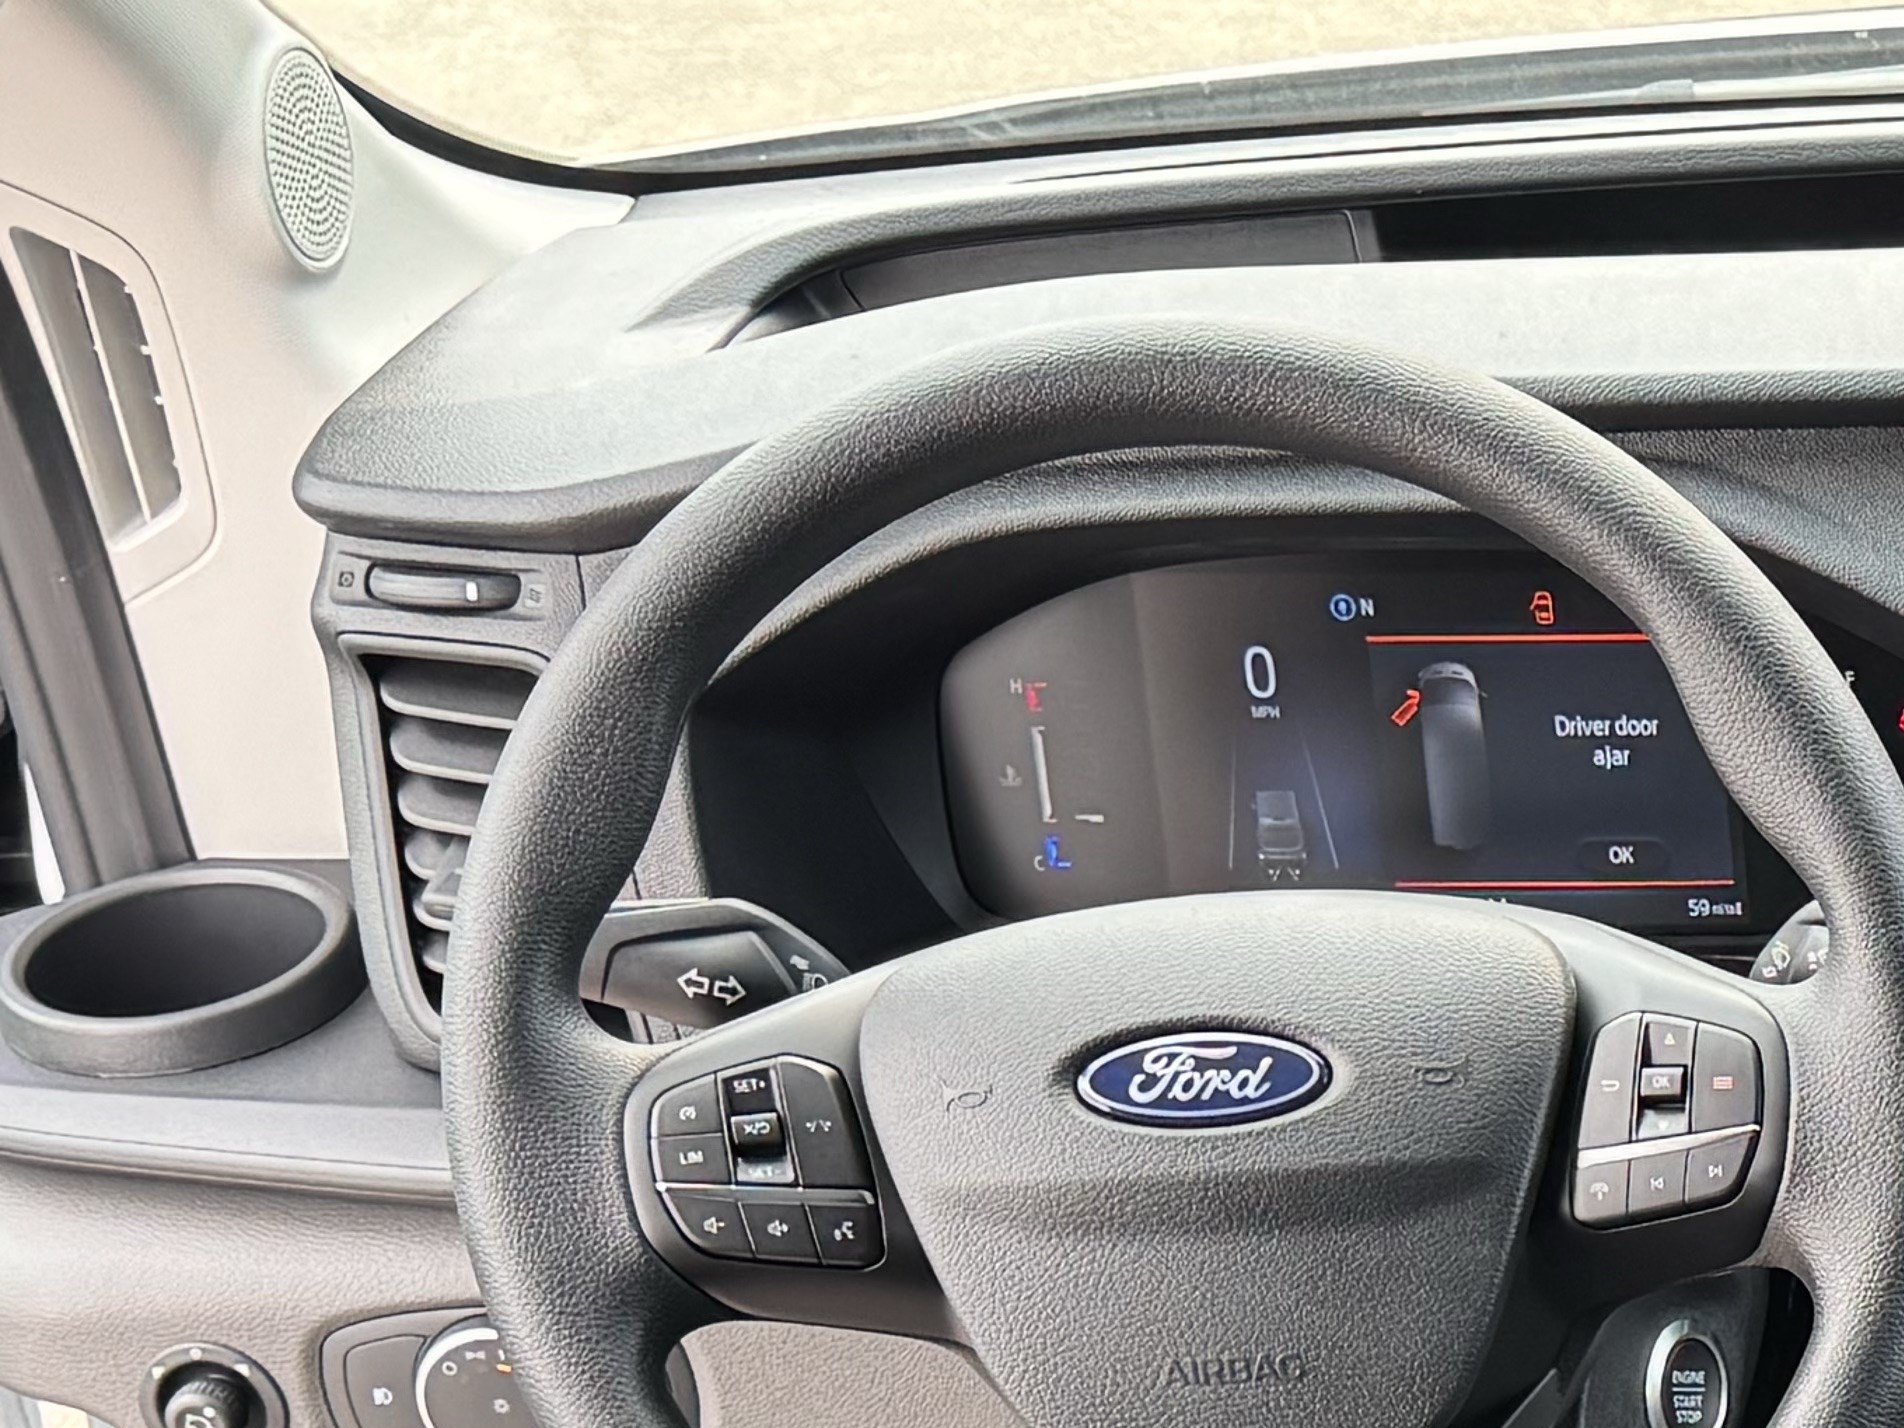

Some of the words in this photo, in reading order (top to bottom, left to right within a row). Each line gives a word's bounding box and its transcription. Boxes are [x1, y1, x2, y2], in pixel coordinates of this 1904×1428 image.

[1359, 598, 1375, 617] N
[1244, 645, 1277, 699] 0
[1010, 678, 1023, 694] H
[1250, 705, 1281, 720] MPH
[1554, 714, 1610, 737] Driver
[1614, 714, 1659, 737] door
[1593, 745, 1630, 770] ajar
[1034, 855, 1046, 872] C
[1608, 845, 1635, 864] OK
[1687, 898, 1711, 917] 59
[1128, 1044, 1273, 1104] Ford
[1651, 1076, 1671, 1089] OK
[1164, 1352, 1303, 1388] AIRBAG
[1671, 1370, 1706, 1385] ENGINE
[1672, 1394, 1704, 1409] START
[1675, 1410, 1703, 1424] STOP
